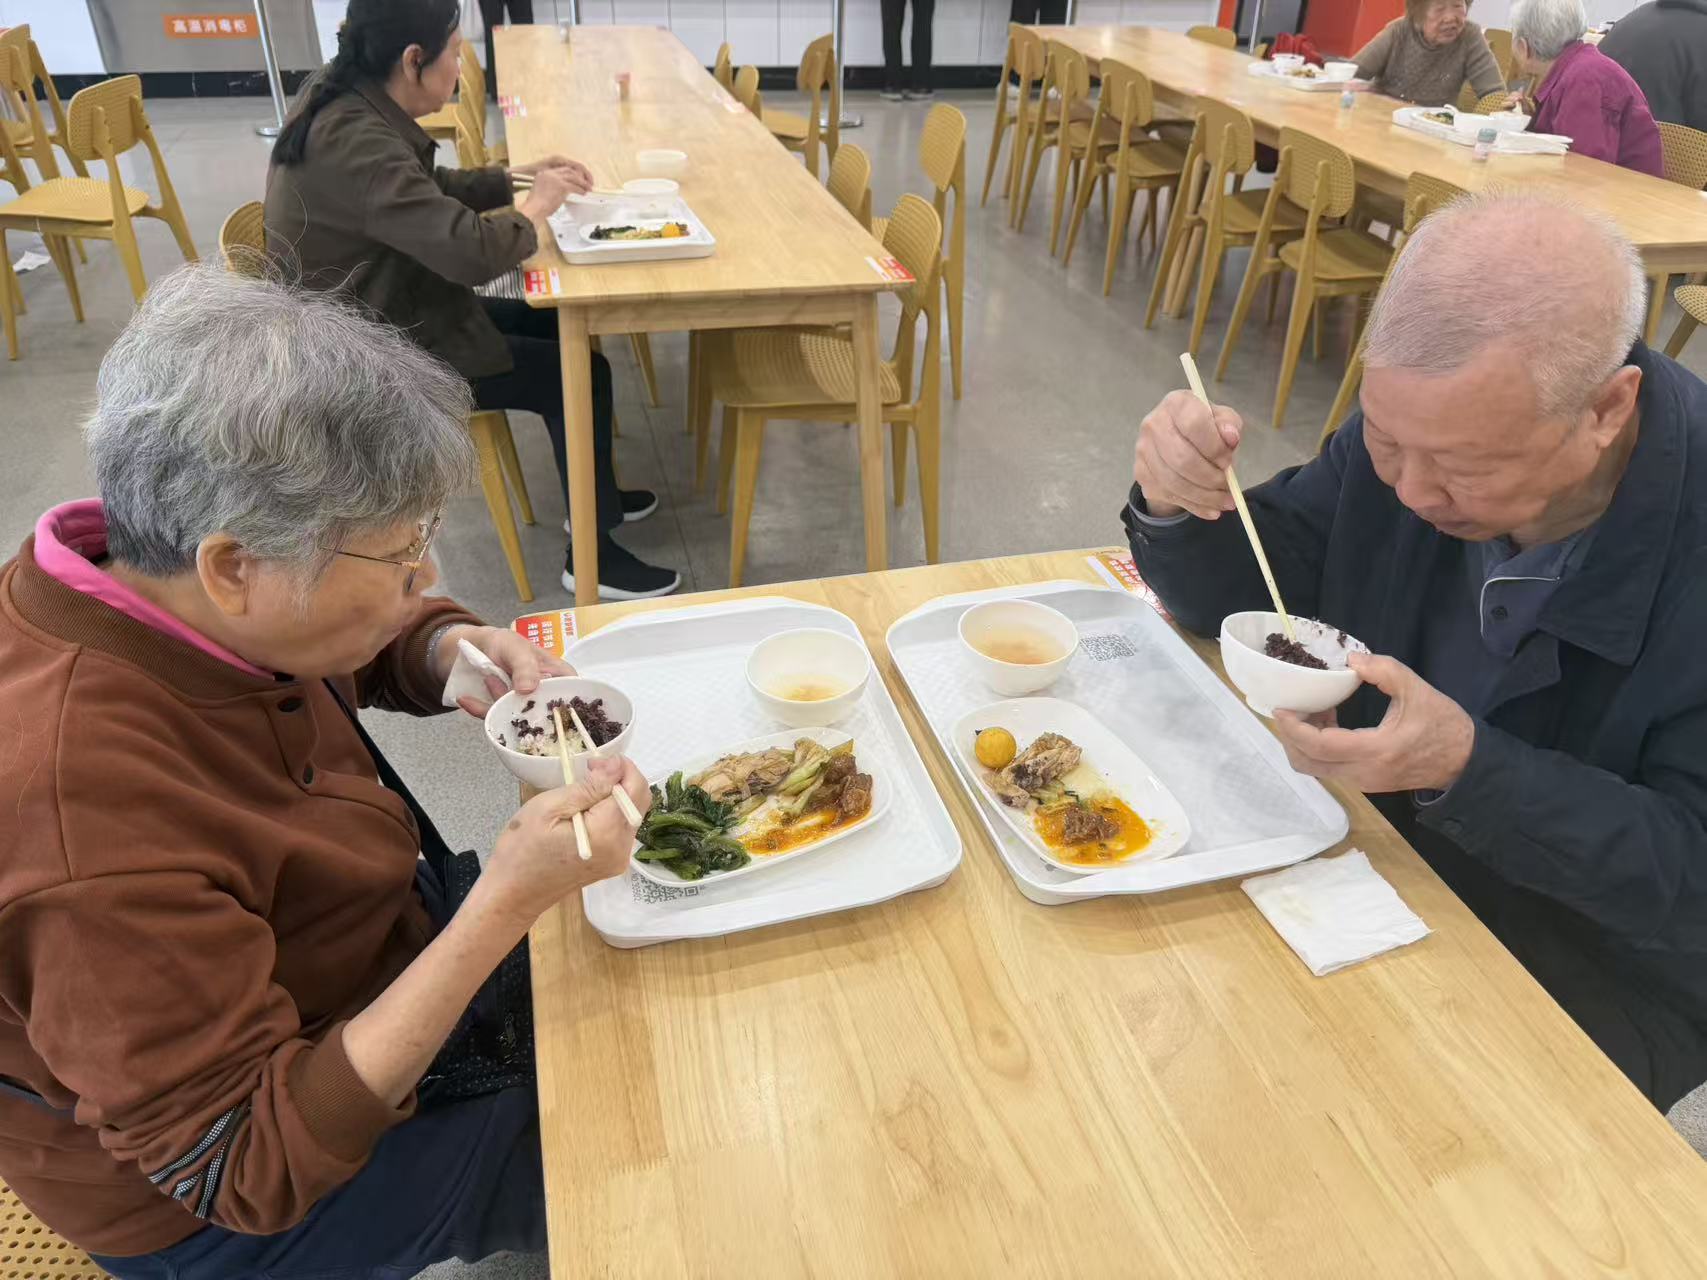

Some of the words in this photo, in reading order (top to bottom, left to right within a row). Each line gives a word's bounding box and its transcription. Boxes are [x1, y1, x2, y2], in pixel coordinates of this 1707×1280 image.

[172, 18, 248, 34] 高温消毒柜
